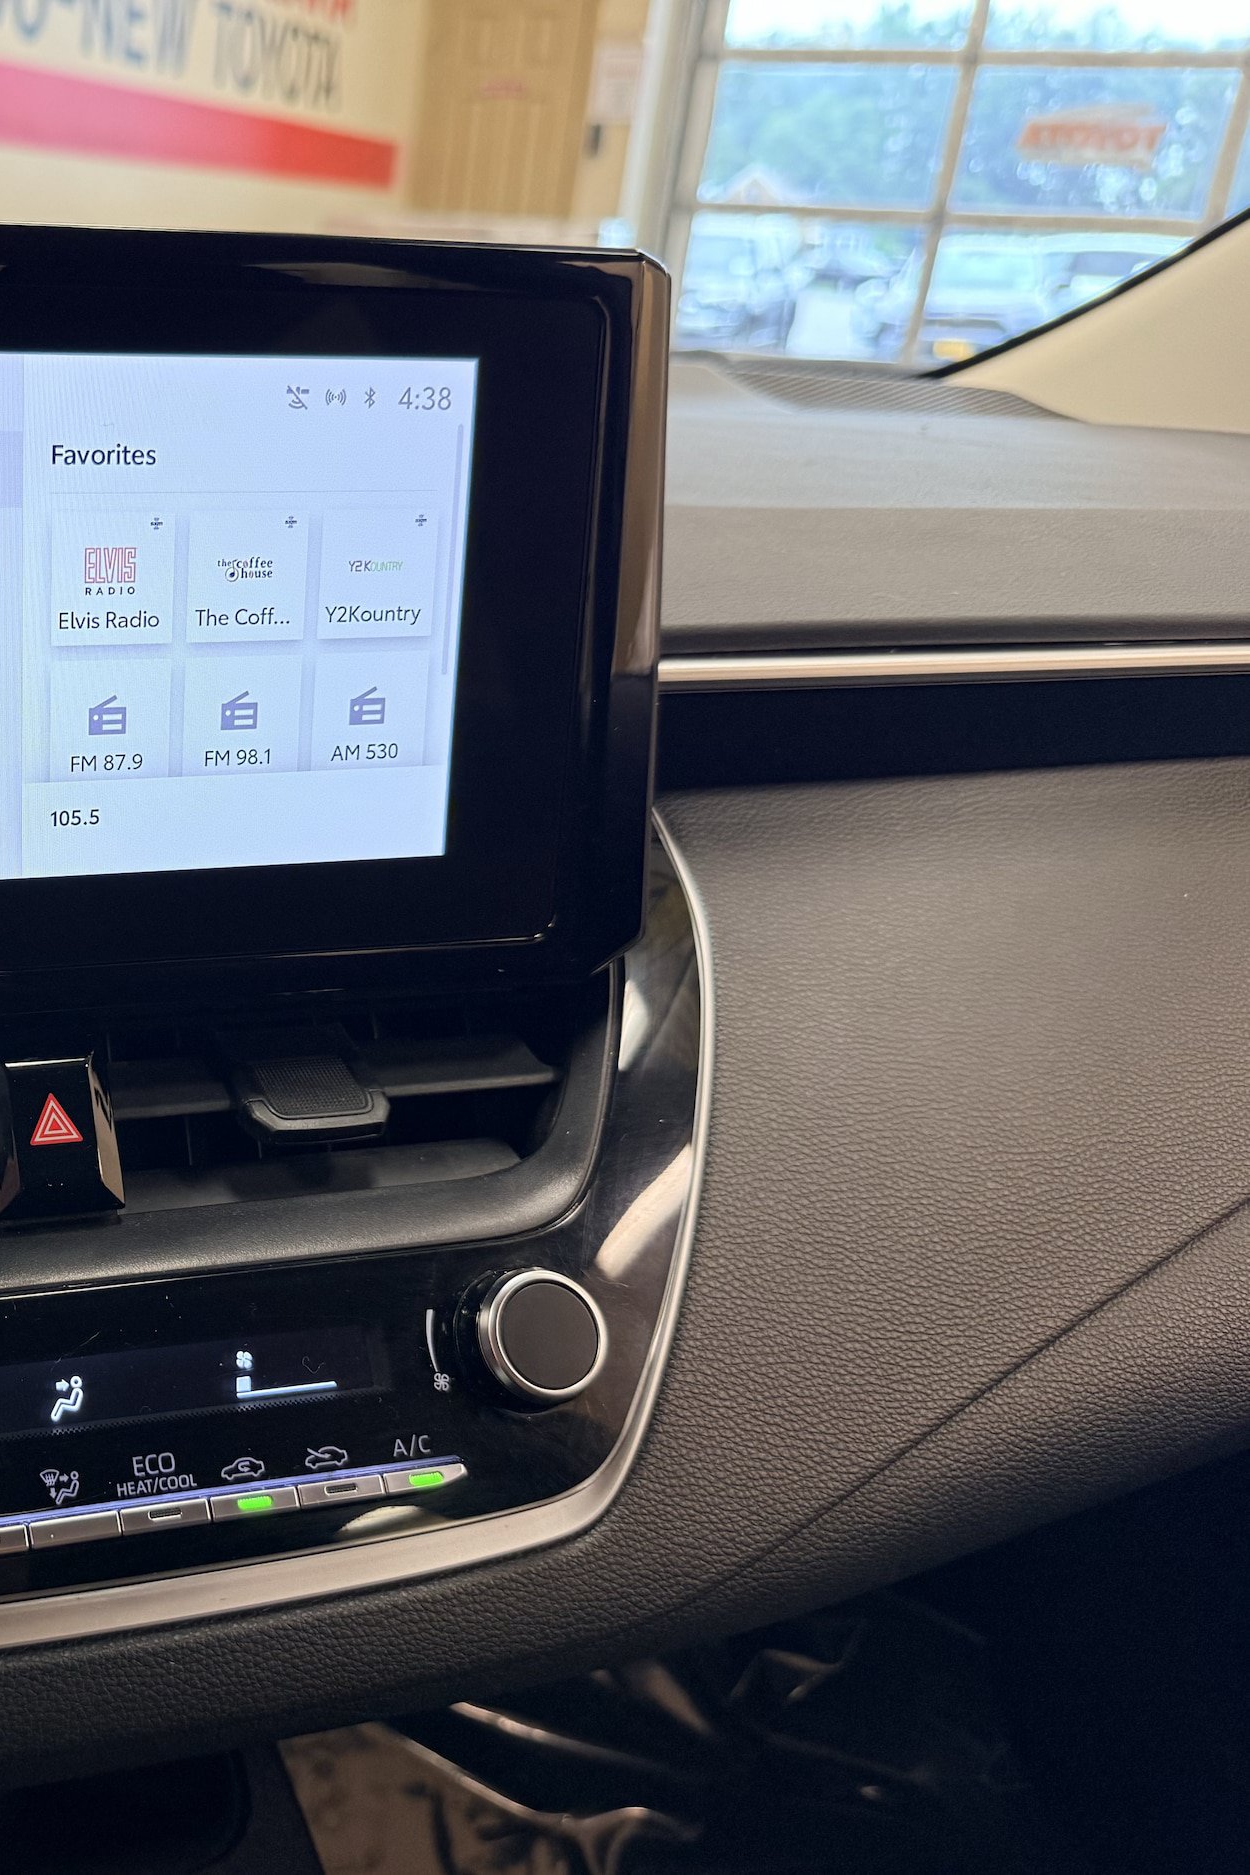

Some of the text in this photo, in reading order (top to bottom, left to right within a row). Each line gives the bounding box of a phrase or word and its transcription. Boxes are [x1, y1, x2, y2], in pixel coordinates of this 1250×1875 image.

[397, 386, 452, 411] 4:38
[52, 443, 156, 466] Favorites
[84, 547, 137, 584] ELVIS
[217, 556, 273, 569] the coffee
[240, 567, 273, 579] house
[85, 586, 136, 596] RADIO
[59, 609, 160, 630] Elvis Radio
[195, 607, 290, 627] The Coff...
[325, 605, 421, 626] Y2Kountry
[204, 748, 271, 767] FM 98.1
[330, 742, 398, 762] AM 530
[71, 753, 143, 773] FM 87.9
[50, 808, 100, 827] 105.5
[393, 1435, 432, 1457] A/C
[132, 1452, 176, 1477] ECO
[116, 1473, 197, 1498] HEAT/COOL
